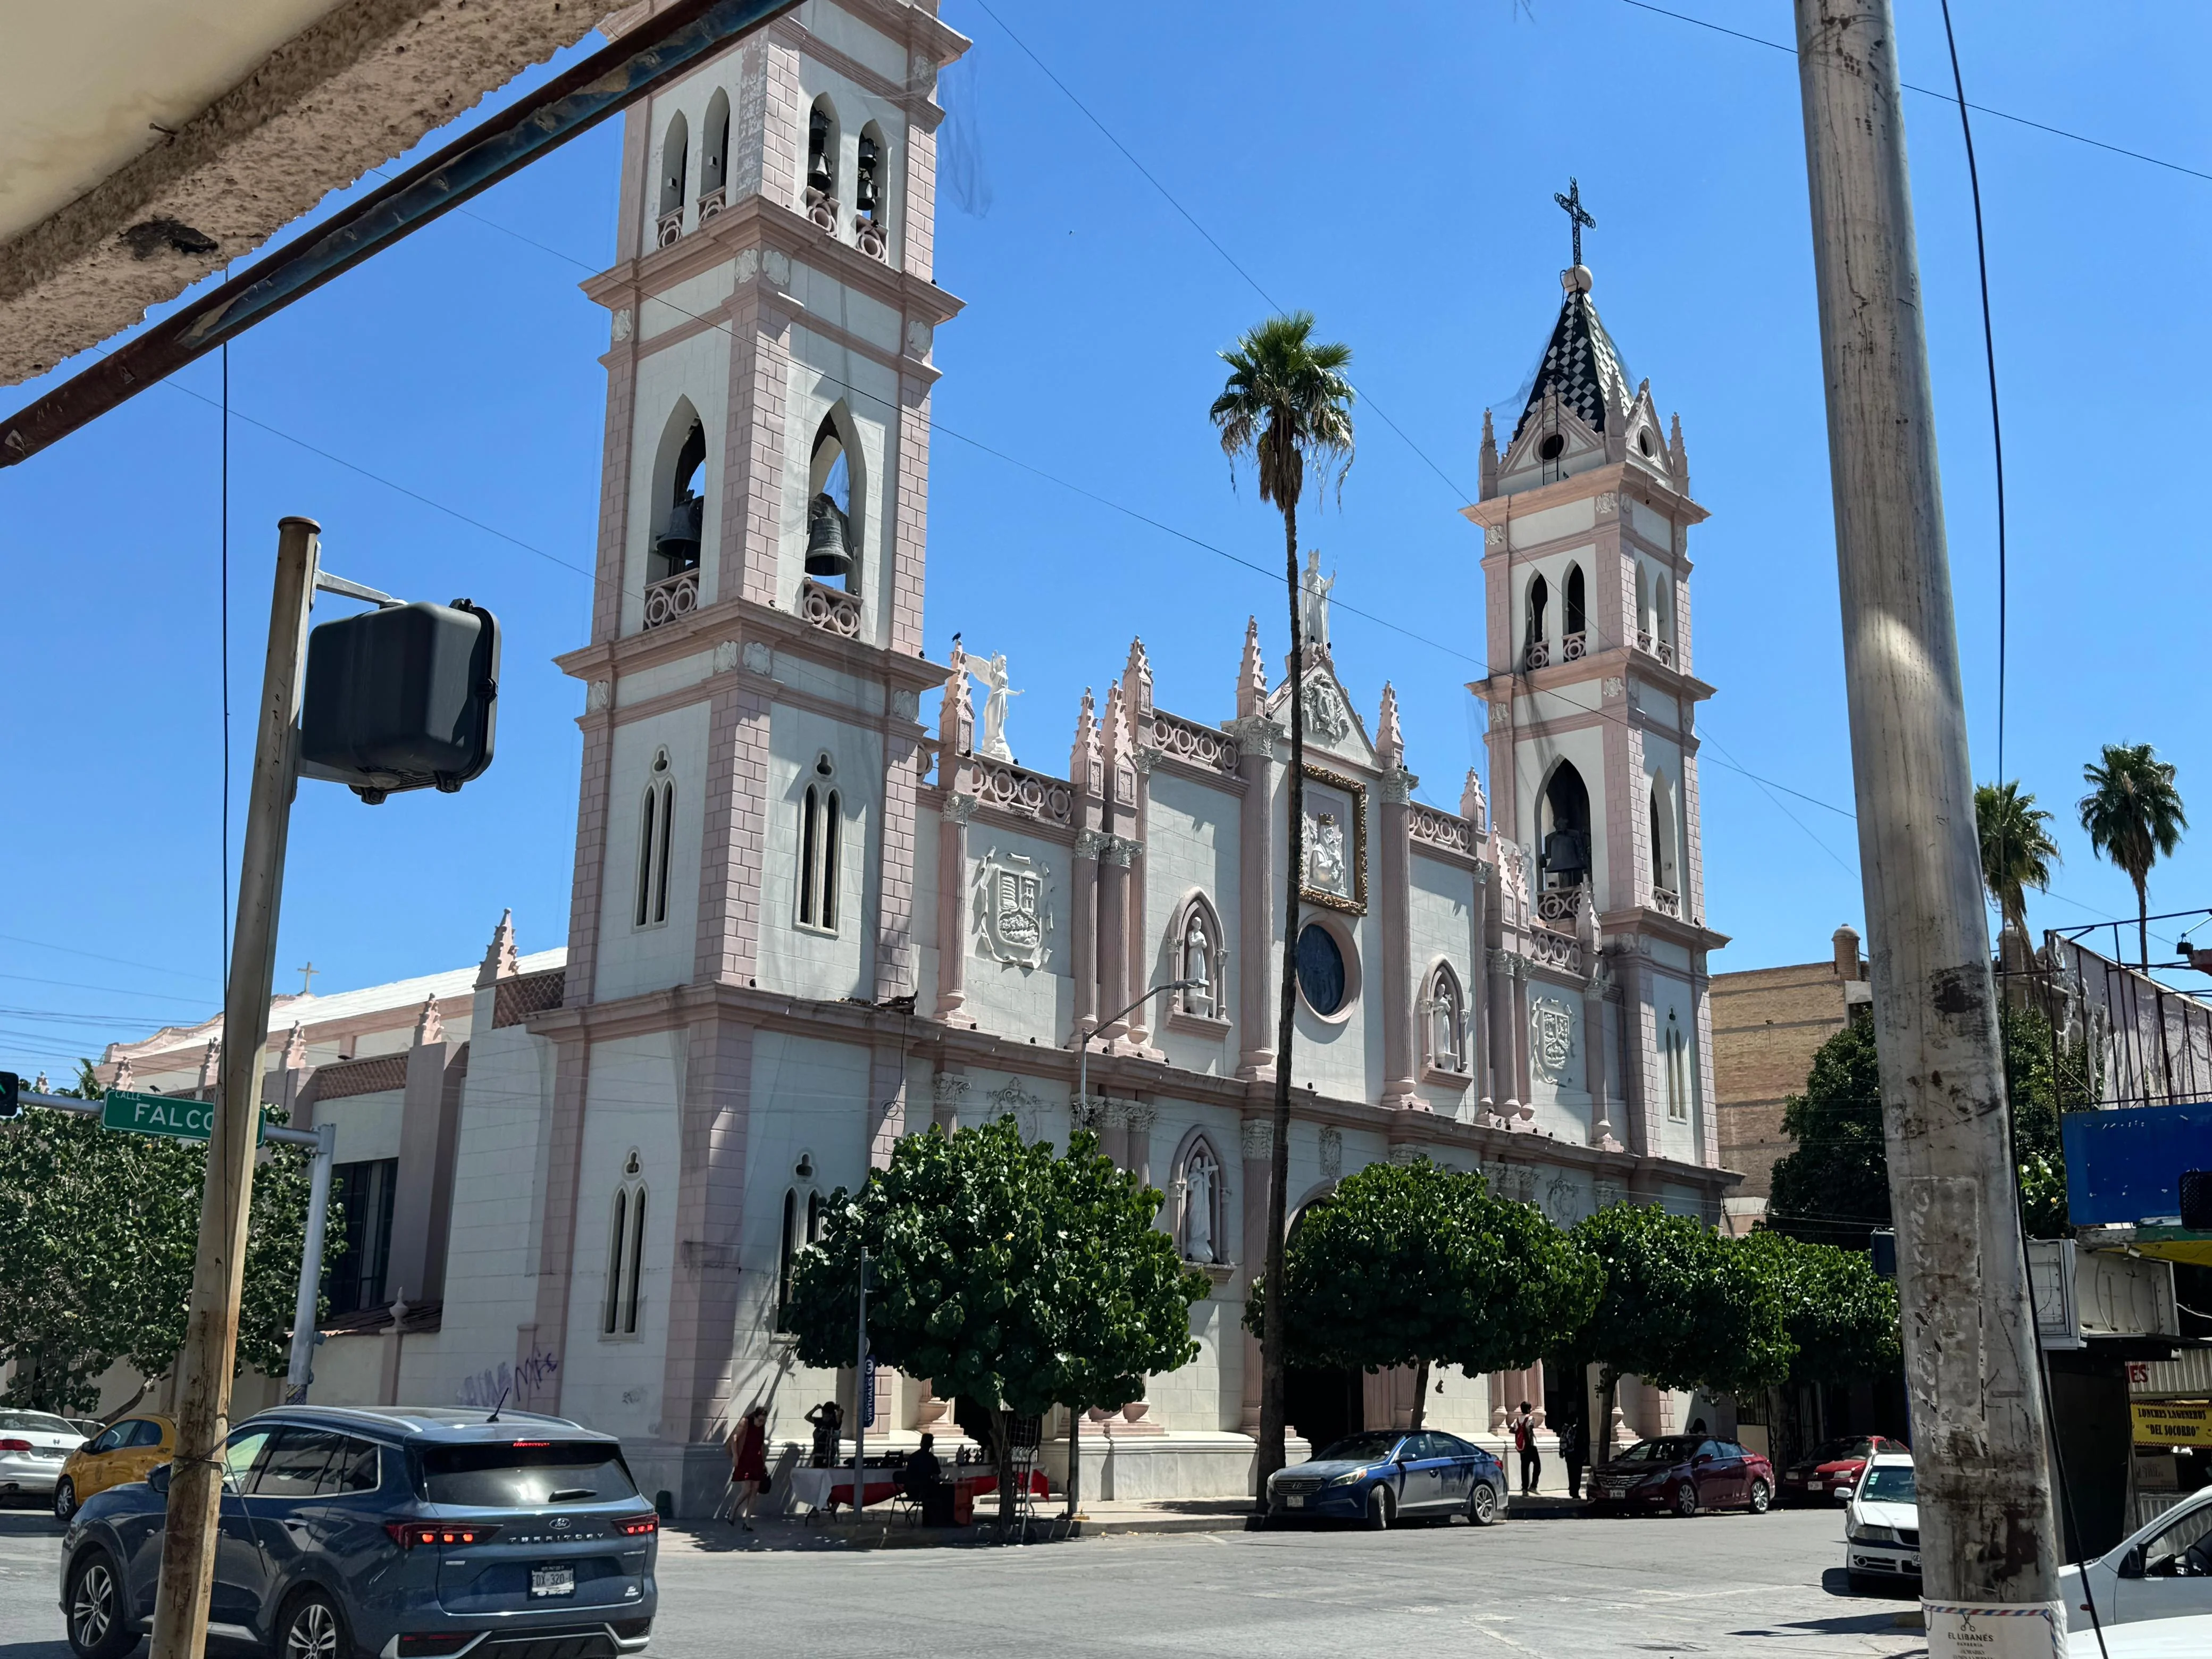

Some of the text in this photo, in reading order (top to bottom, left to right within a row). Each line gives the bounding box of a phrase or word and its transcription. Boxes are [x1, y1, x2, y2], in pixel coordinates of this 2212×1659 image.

[114, 1091, 141, 1101] CALLE
[134, 1103, 214, 1131] FALCO
[2125, 1364, 2148, 1382] ES
[2138, 1408, 2207, 1420] LONCHES LAGUNEROS
[509, 1532, 604, 1542] TERRITORY
[1957, 1632, 1993, 1642] LIBANÉS
